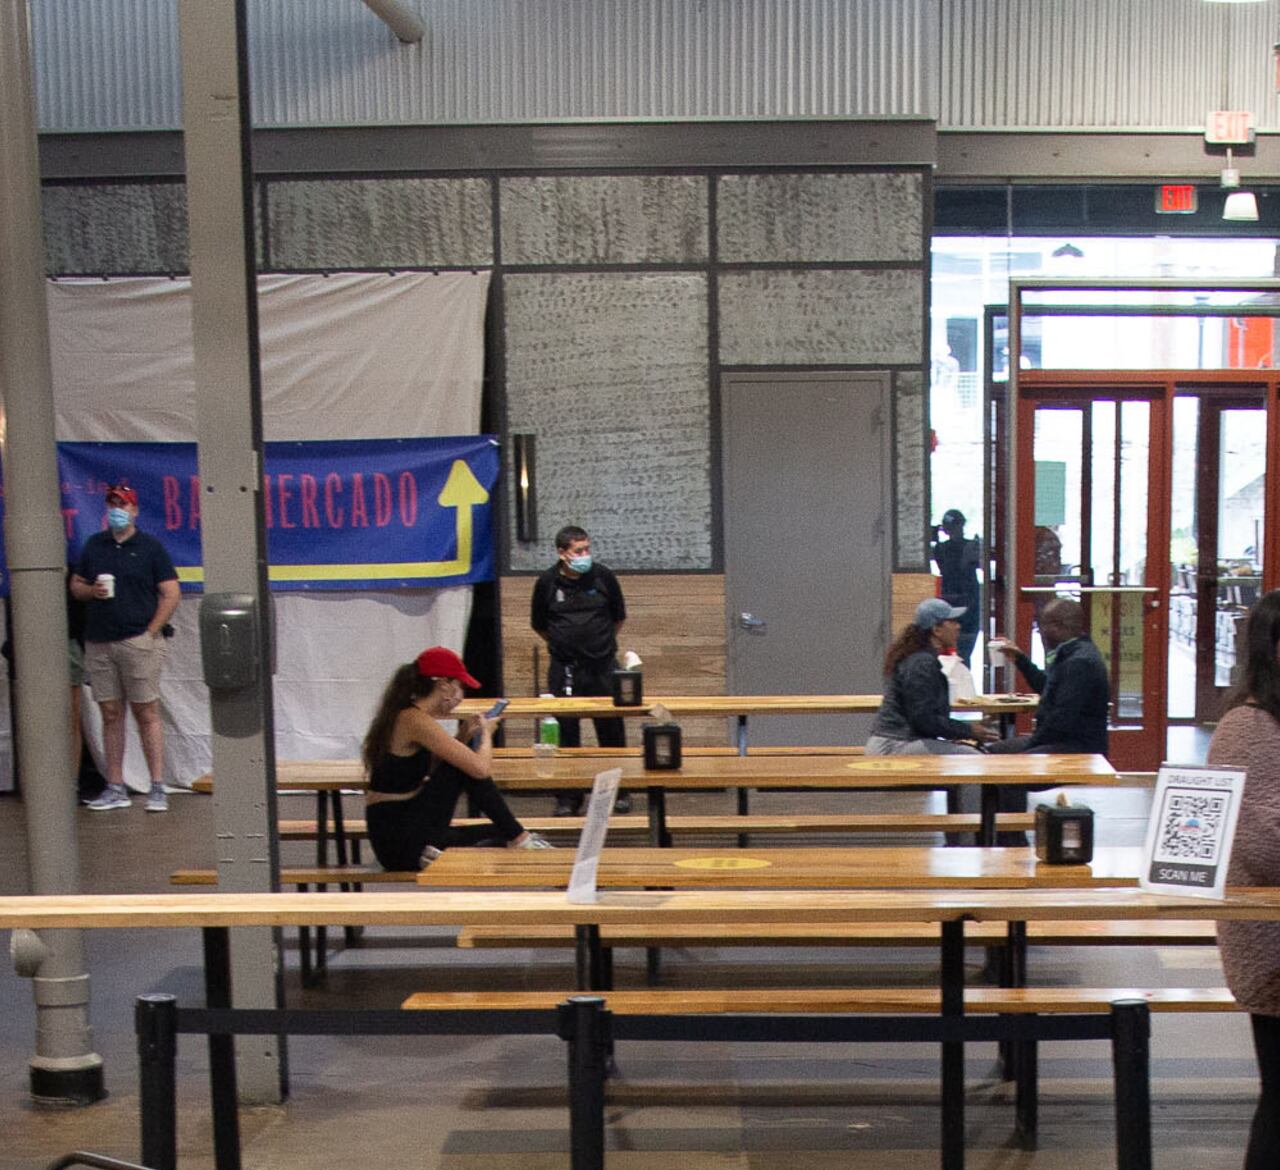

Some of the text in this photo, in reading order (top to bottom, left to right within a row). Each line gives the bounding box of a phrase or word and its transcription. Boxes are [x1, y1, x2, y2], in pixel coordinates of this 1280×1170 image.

[1215, 111, 1249, 140] EXIT
[1161, 185, 1194, 210] EXIT
[163, 474, 201, 530] BA
[1215, 777, 1234, 787] LIST
[1159, 868, 1208, 883] SCAN ME
